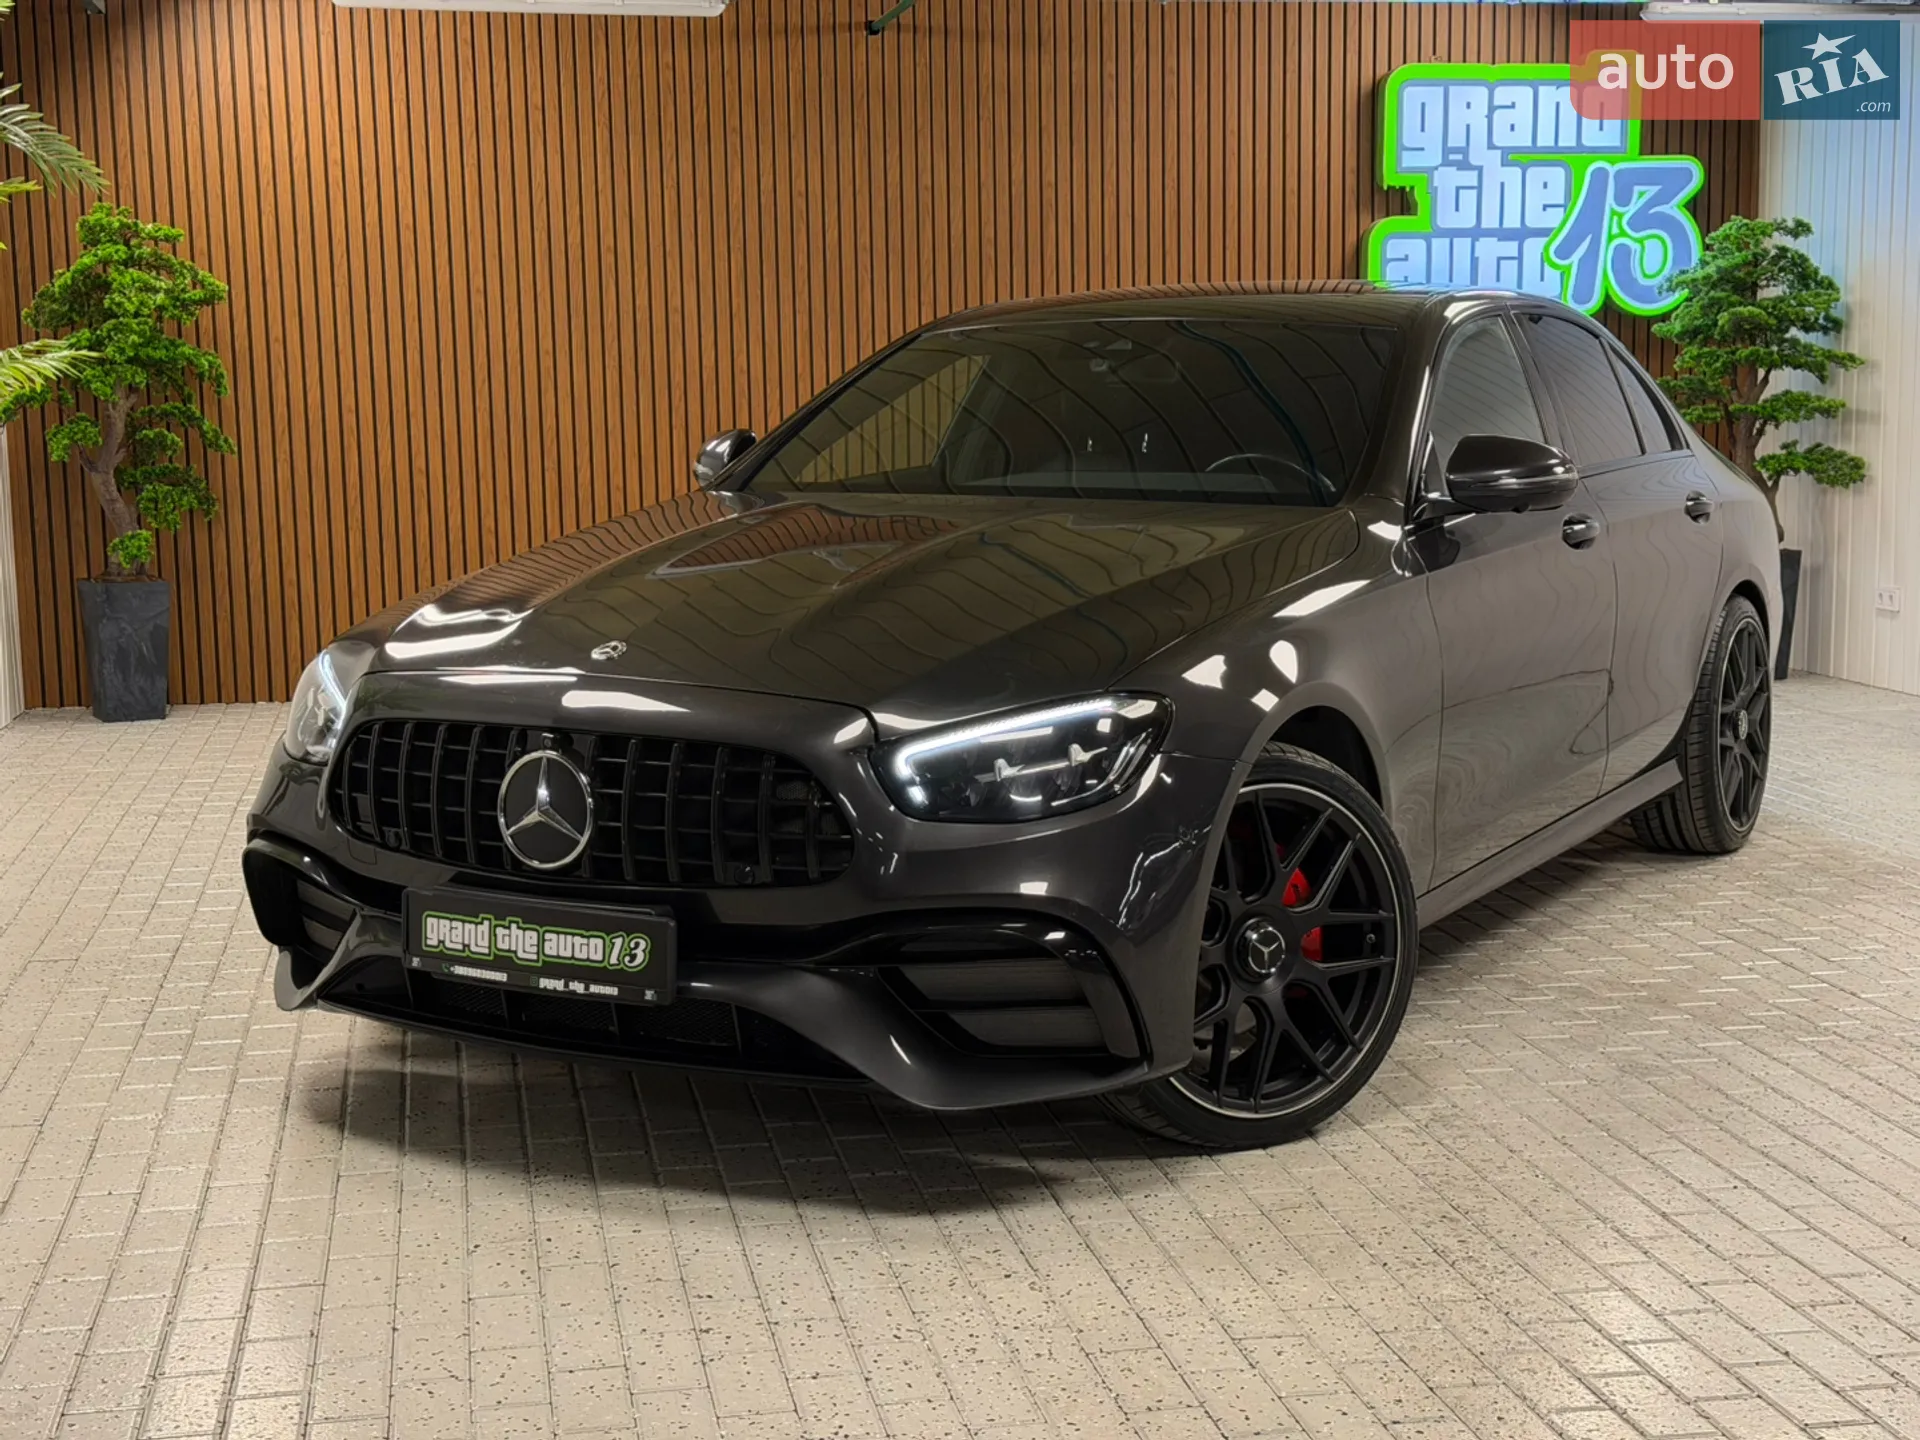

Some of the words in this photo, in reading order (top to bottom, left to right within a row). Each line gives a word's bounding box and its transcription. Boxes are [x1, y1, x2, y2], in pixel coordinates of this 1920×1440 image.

[1401, 68, 1624, 169] grand
[1432, 150, 1567, 229] the
[1386, 237, 1561, 297] auto
[1551, 162, 1699, 310] 13
[425, 916, 490, 954] grand
[495, 923, 539, 960] the
[543, 932, 604, 962] auto
[607, 935, 648, 969] 13
